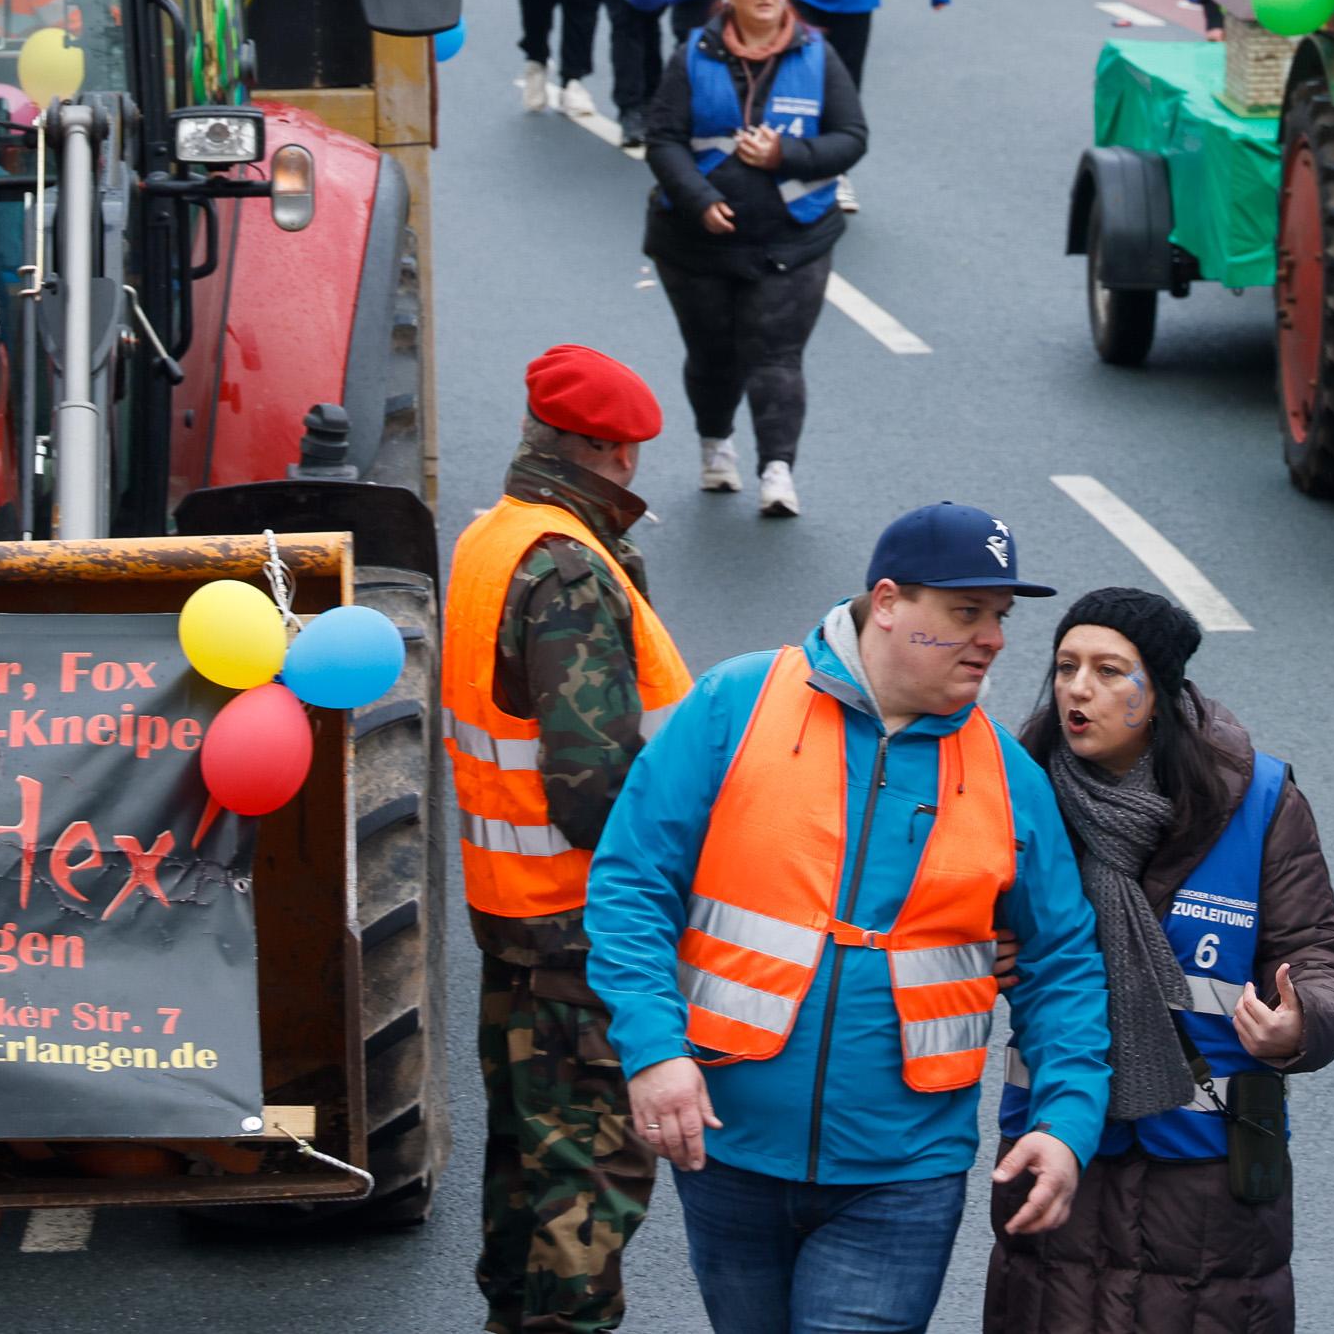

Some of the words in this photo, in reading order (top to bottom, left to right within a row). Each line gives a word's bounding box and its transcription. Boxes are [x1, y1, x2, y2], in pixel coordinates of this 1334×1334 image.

[788, 116, 804, 139] 4
[60, 652, 156, 692] Fox
[1171, 902, 1255, 928] ZUGLEITUNG
[1194, 933, 1220, 969] 6
[72, 1002, 140, 1033] Str.
[157, 1007, 182, 1035] 7
